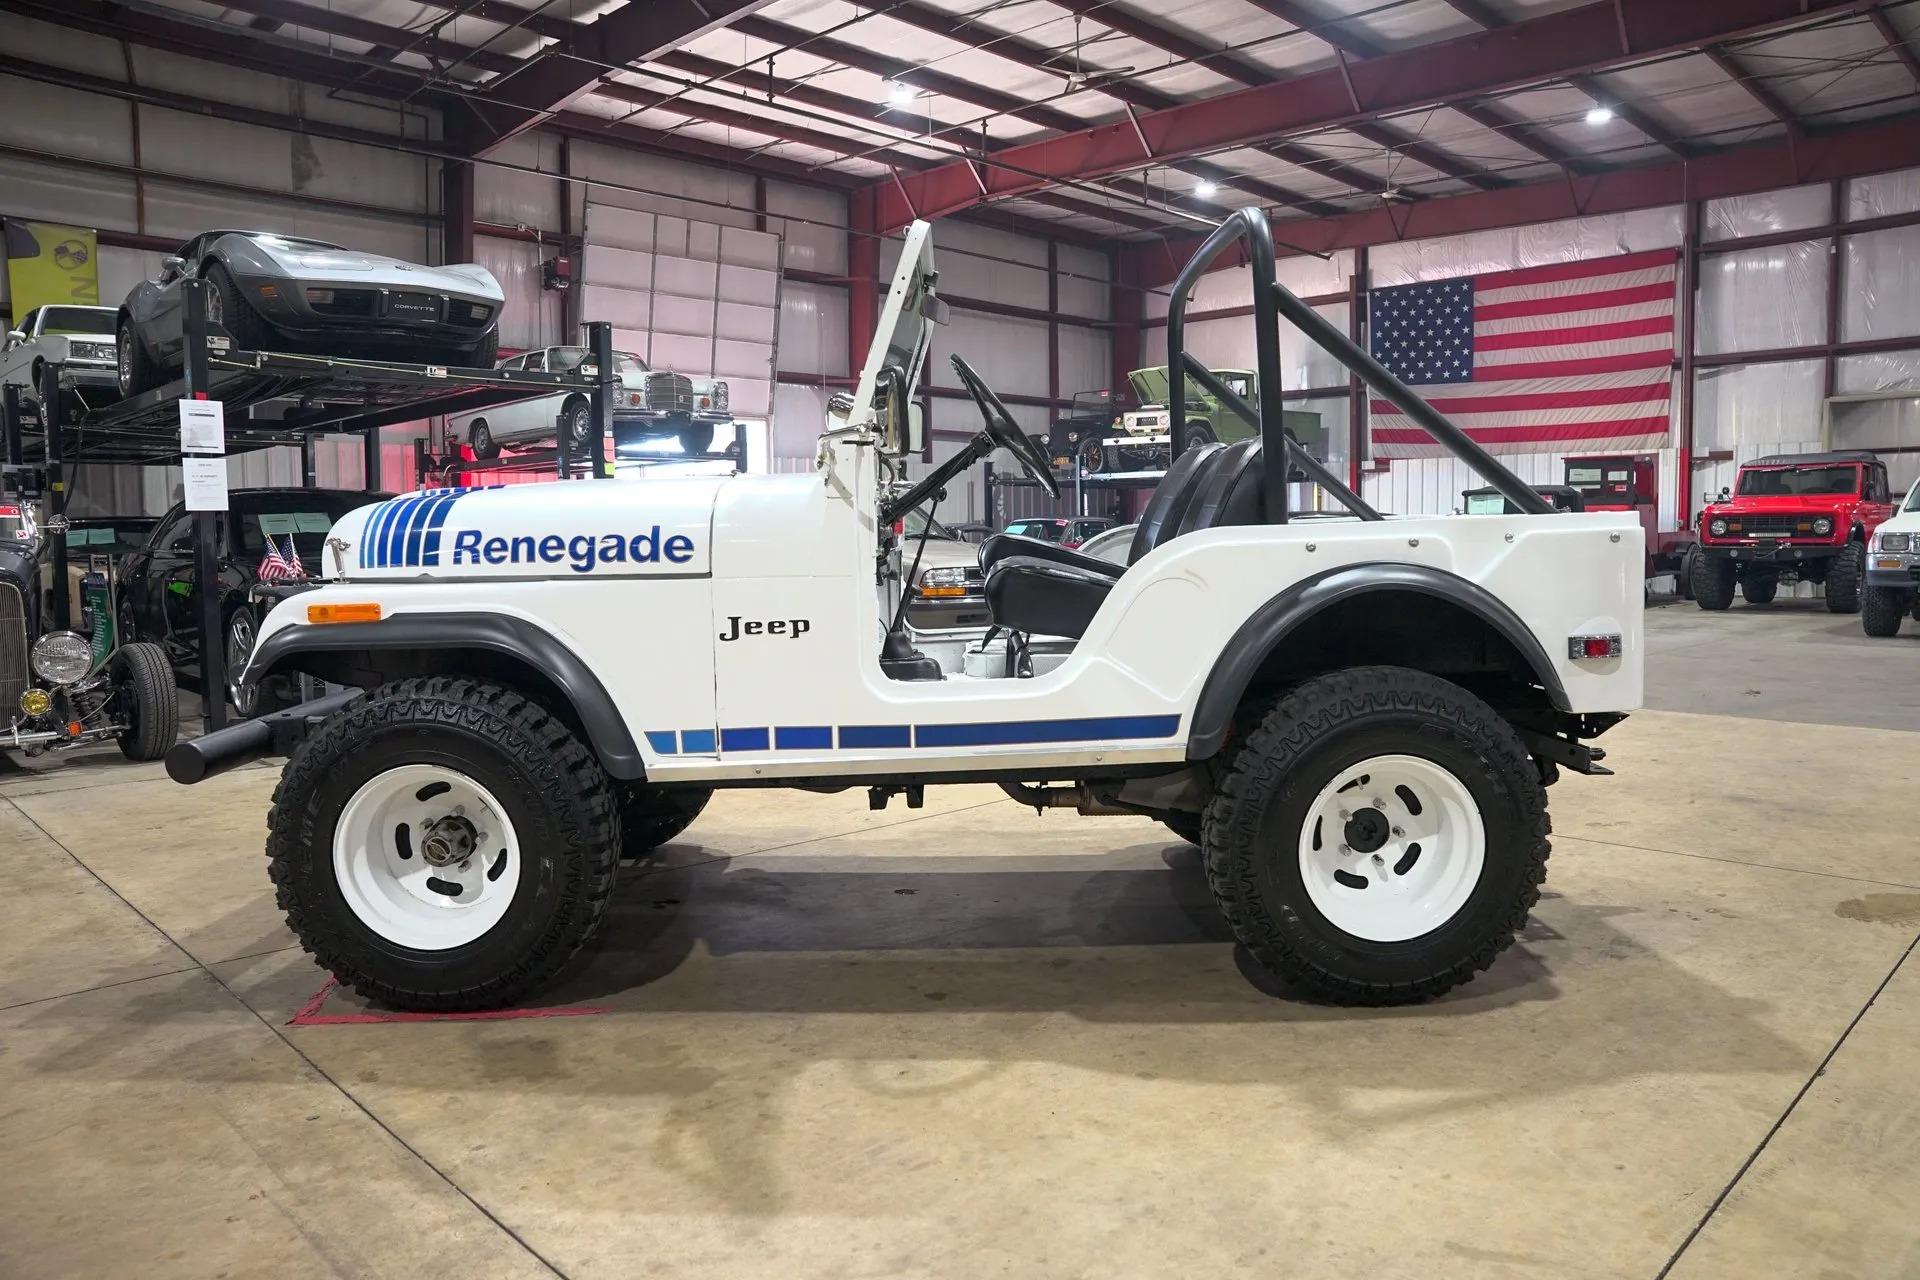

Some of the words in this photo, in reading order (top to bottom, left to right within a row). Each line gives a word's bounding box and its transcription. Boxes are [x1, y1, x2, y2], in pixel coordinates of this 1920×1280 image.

[394, 303, 435, 311] CORVETTE
[453, 525, 695, 573] Renegade
[719, 616, 810, 641] Jeep
